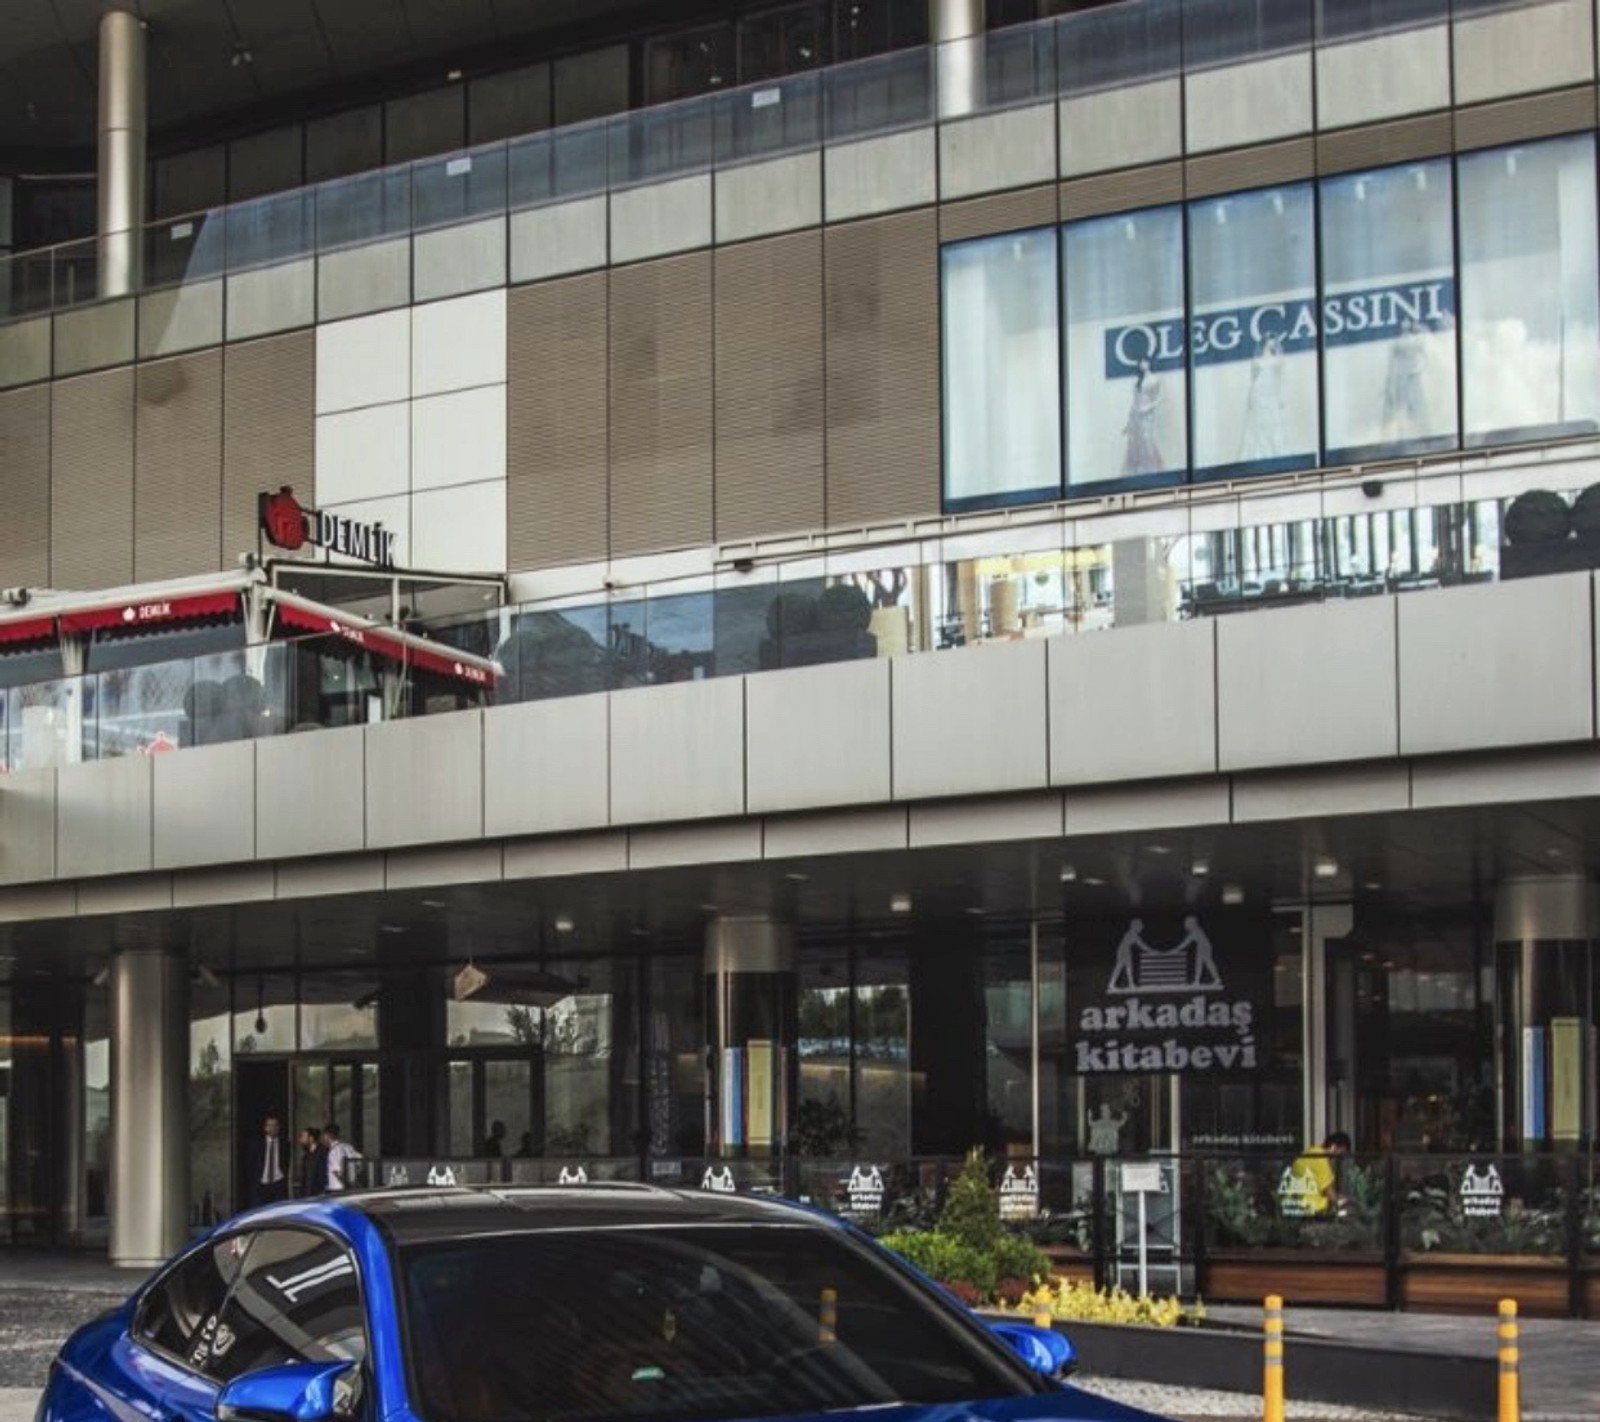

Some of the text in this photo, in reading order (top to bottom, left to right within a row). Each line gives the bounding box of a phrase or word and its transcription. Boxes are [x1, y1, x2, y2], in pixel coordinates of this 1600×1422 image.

[1115, 284, 1445, 367] OLEG CASSINI
[1080, 996, 1253, 1034] arkadaş
[1075, 1036, 1257, 1072] kitabevi
